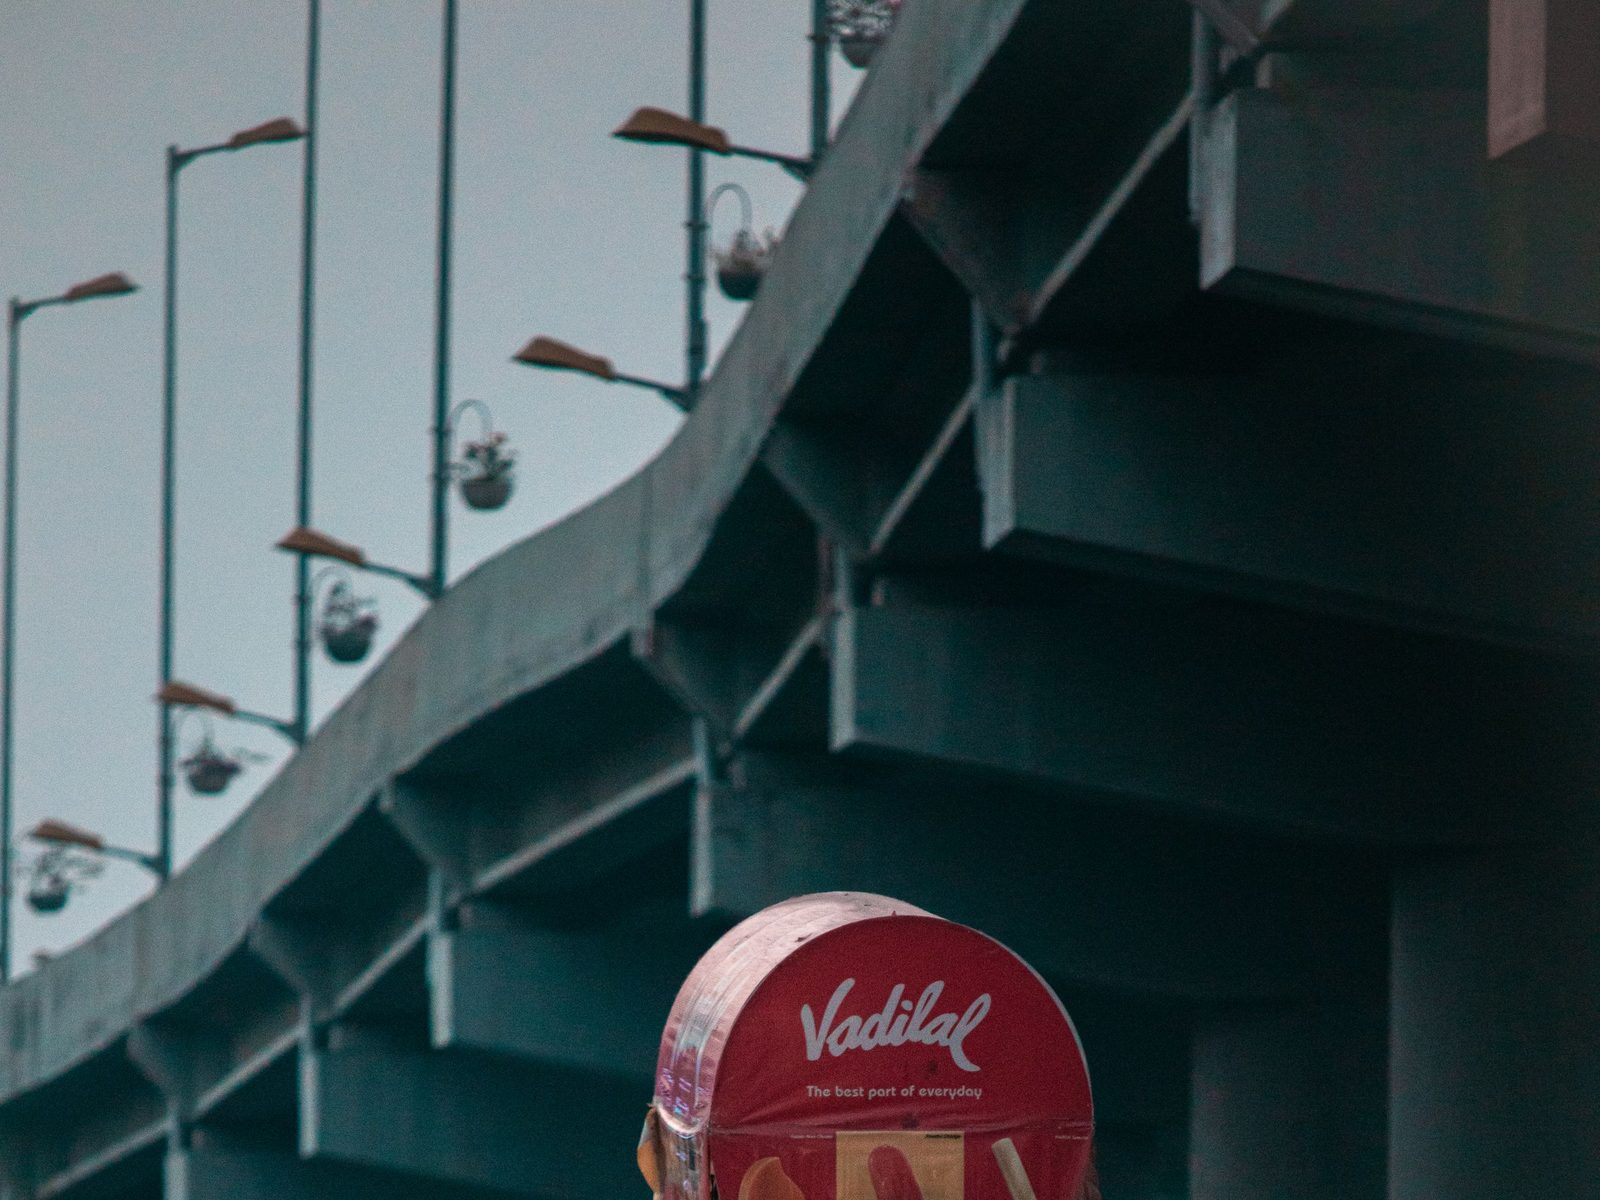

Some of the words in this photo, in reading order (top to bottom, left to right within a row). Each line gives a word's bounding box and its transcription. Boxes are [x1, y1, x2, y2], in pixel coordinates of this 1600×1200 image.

[800, 977, 992, 1073] Vadilal
[806, 1085, 831, 1098] The
[836, 1085, 864, 1098] best
[868, 1086, 897, 1101] part
[900, 1084, 917, 1098] of
[919, 1085, 983, 1102] everyday
